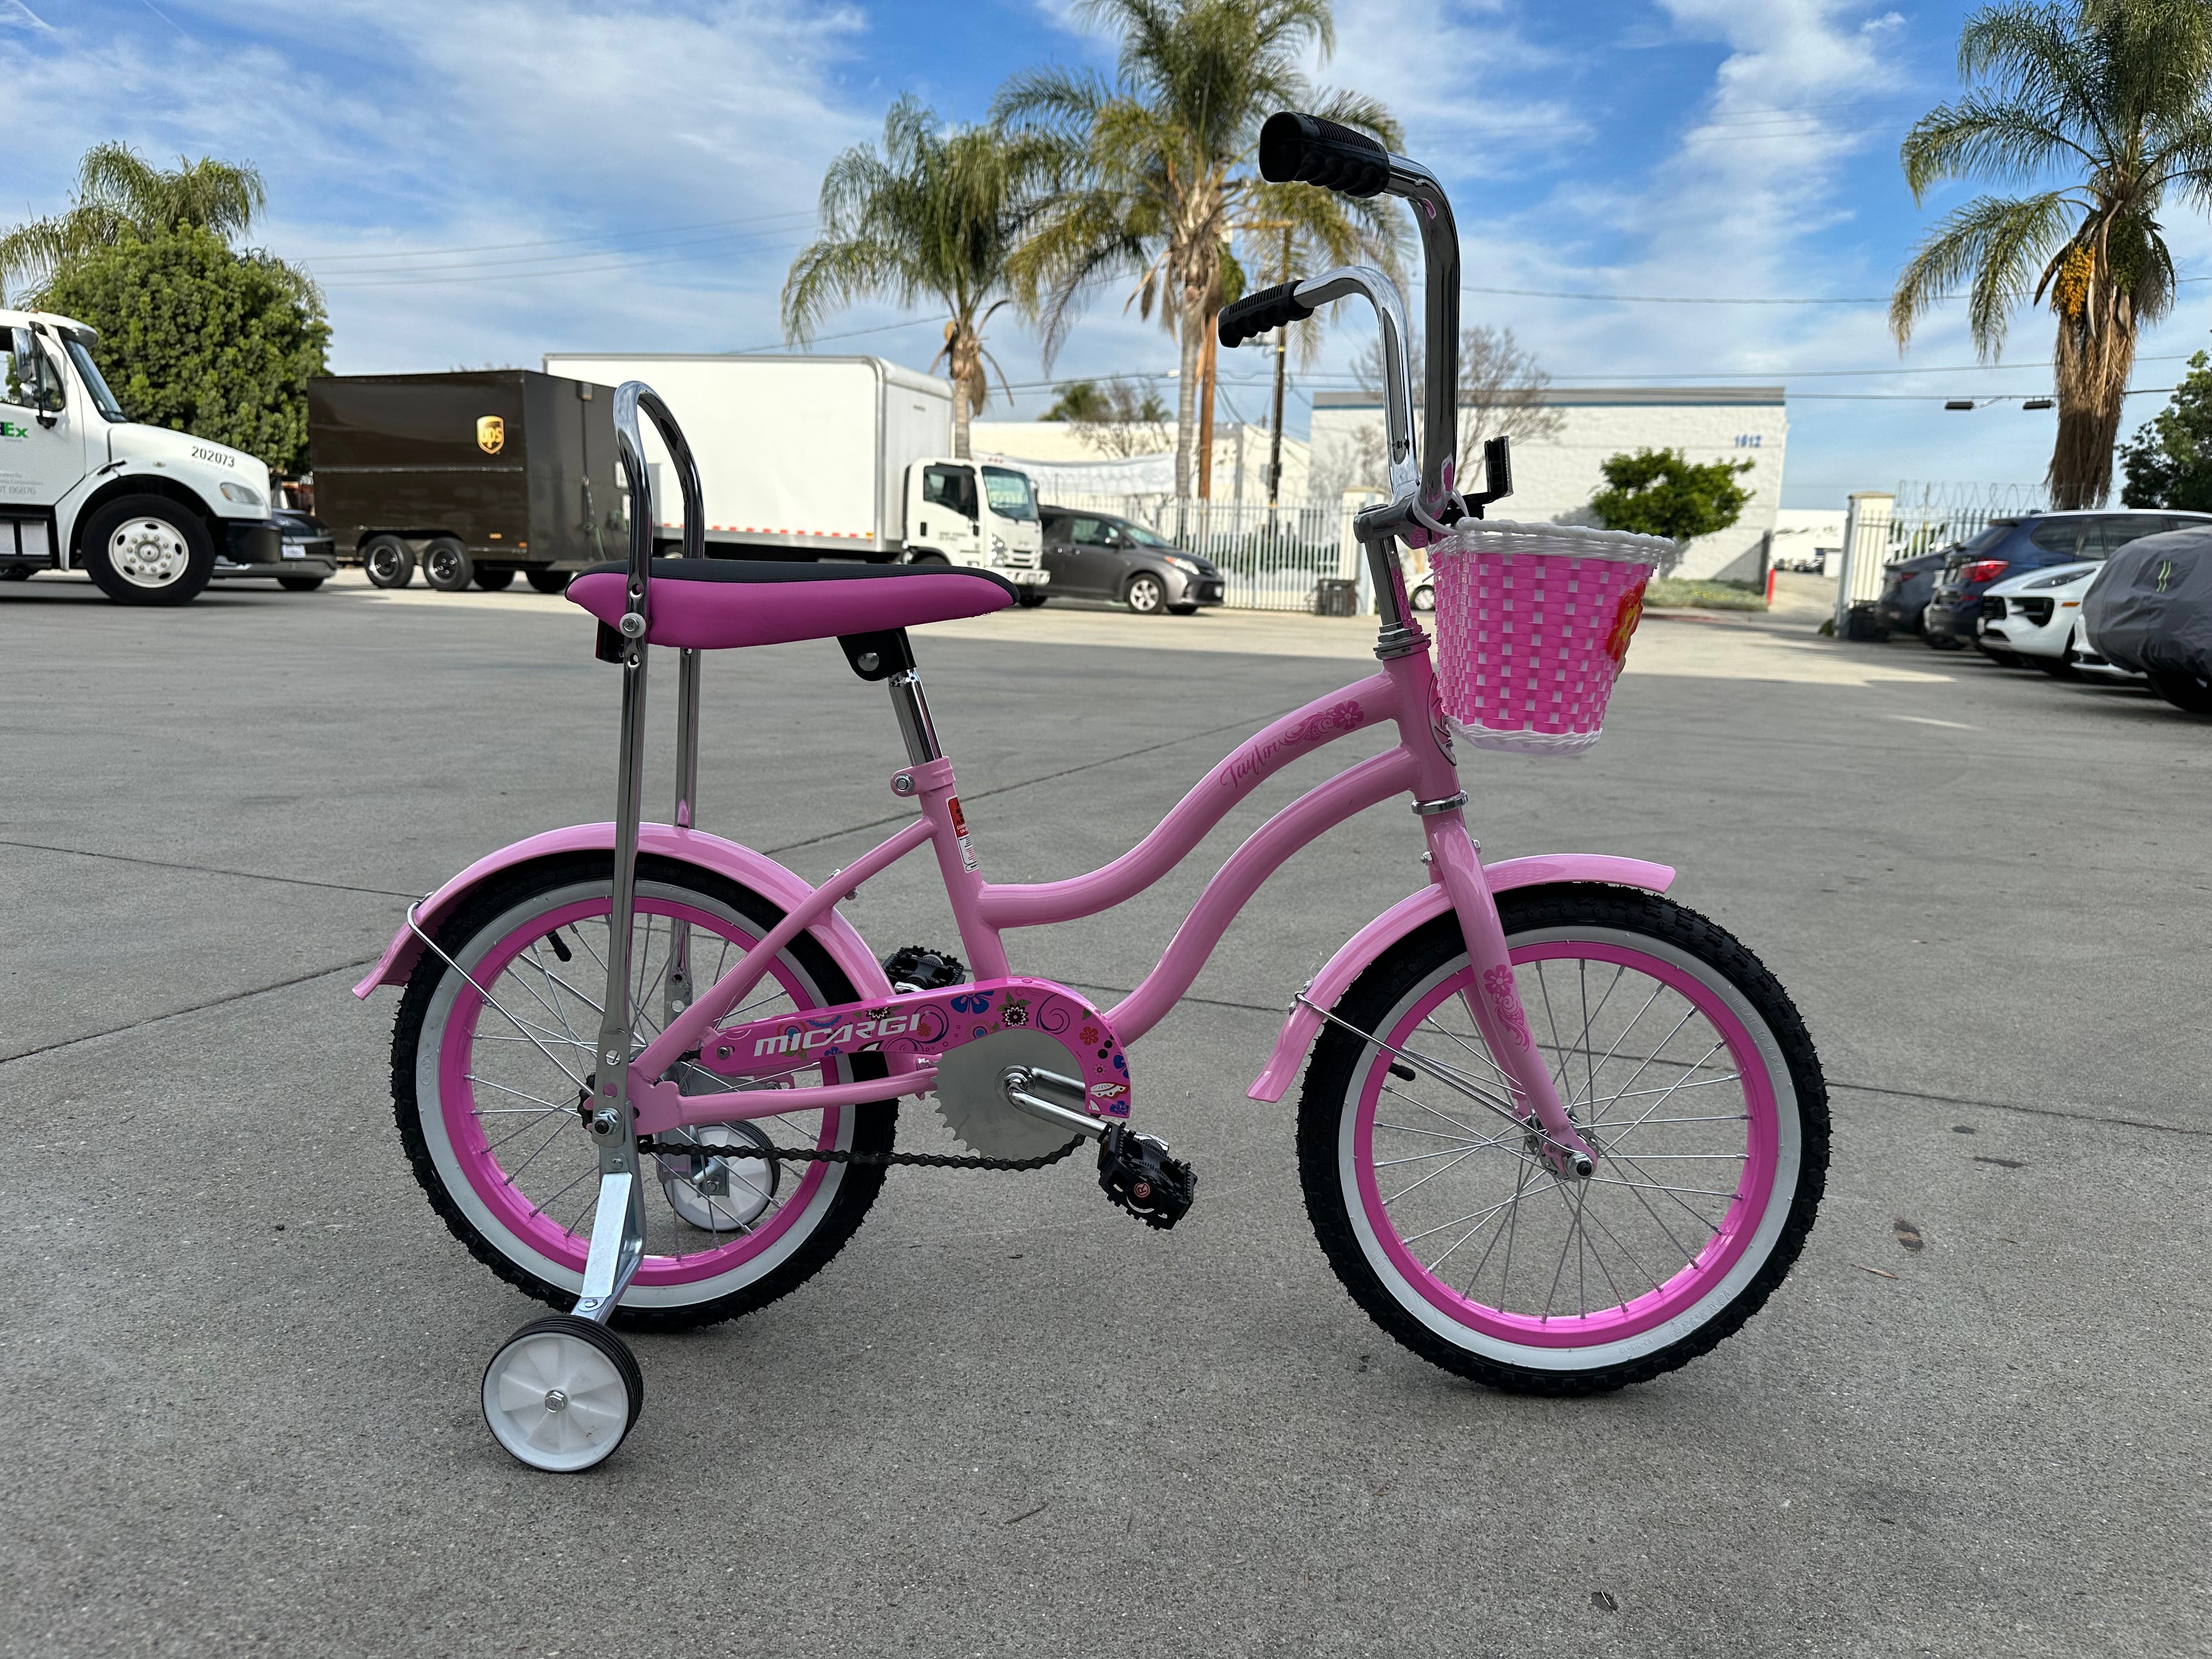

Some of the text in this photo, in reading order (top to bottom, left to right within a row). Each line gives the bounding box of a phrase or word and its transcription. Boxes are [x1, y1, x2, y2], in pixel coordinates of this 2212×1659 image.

[191, 445, 235, 468] 202073
[1220, 741, 1280, 788] Taylor
[754, 1013, 920, 1057] MICARGI
